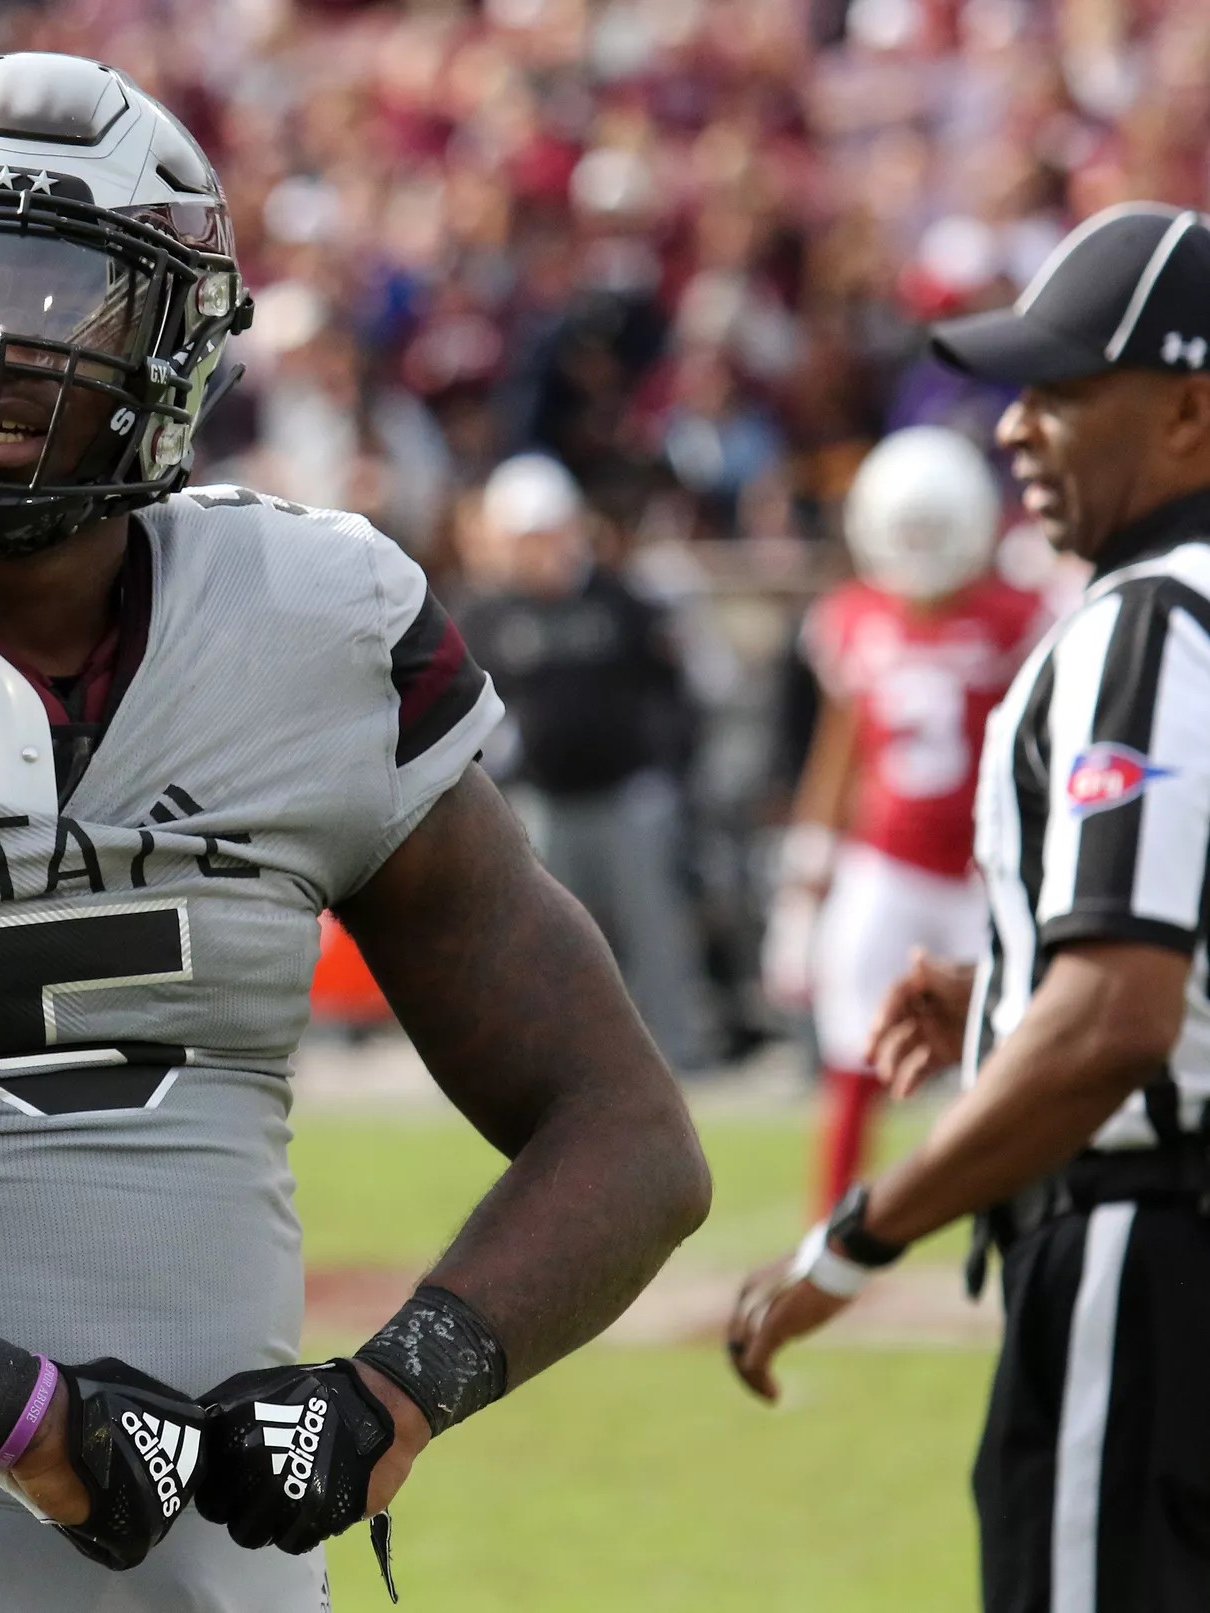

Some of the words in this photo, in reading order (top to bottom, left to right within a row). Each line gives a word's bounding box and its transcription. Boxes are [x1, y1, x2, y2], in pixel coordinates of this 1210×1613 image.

[26, 1388, 49, 1423] ABUSE
[283, 1397, 328, 1500] adidas
[121, 1411, 181, 1518] adidas
